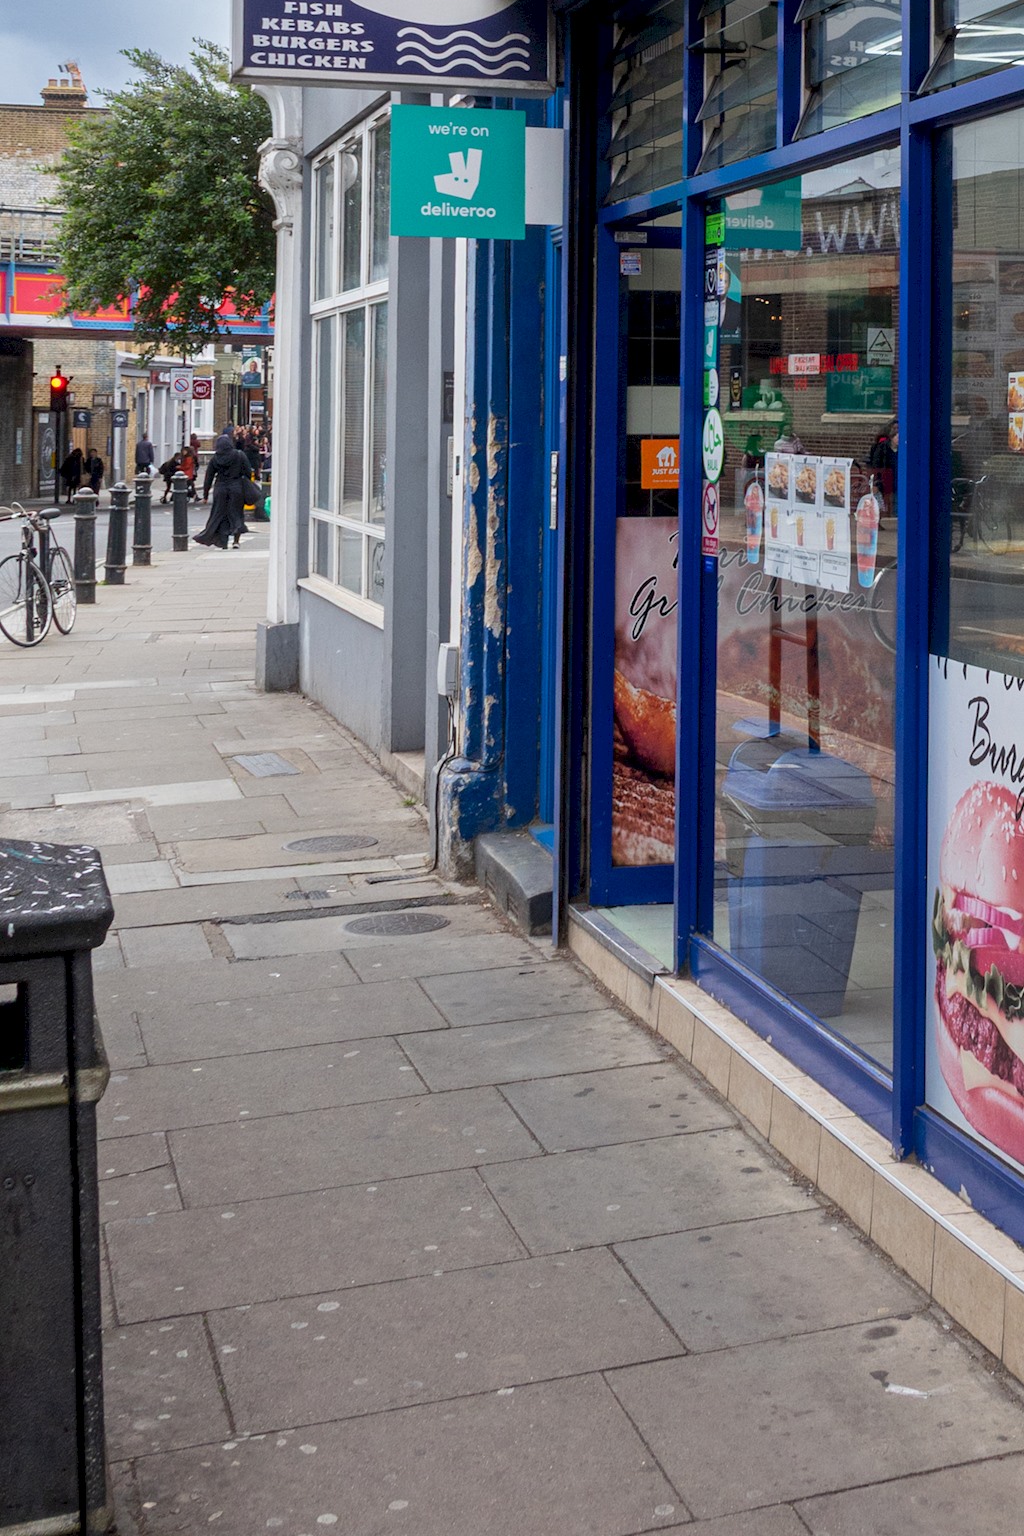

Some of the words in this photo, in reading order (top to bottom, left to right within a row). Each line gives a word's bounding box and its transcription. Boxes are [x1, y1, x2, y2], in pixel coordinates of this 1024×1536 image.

[284, 1, 343, 17] FISH
[261, 17, 365, 35] KEBABS
[252, 34, 375, 53] BURGERS
[250, 52, 366, 70] CHICKEN
[428, 122, 467, 136] we're
[470, 127, 489, 137] on
[420, 202, 497, 218] deliveroo
[736, 570, 884, 616] Chicken
